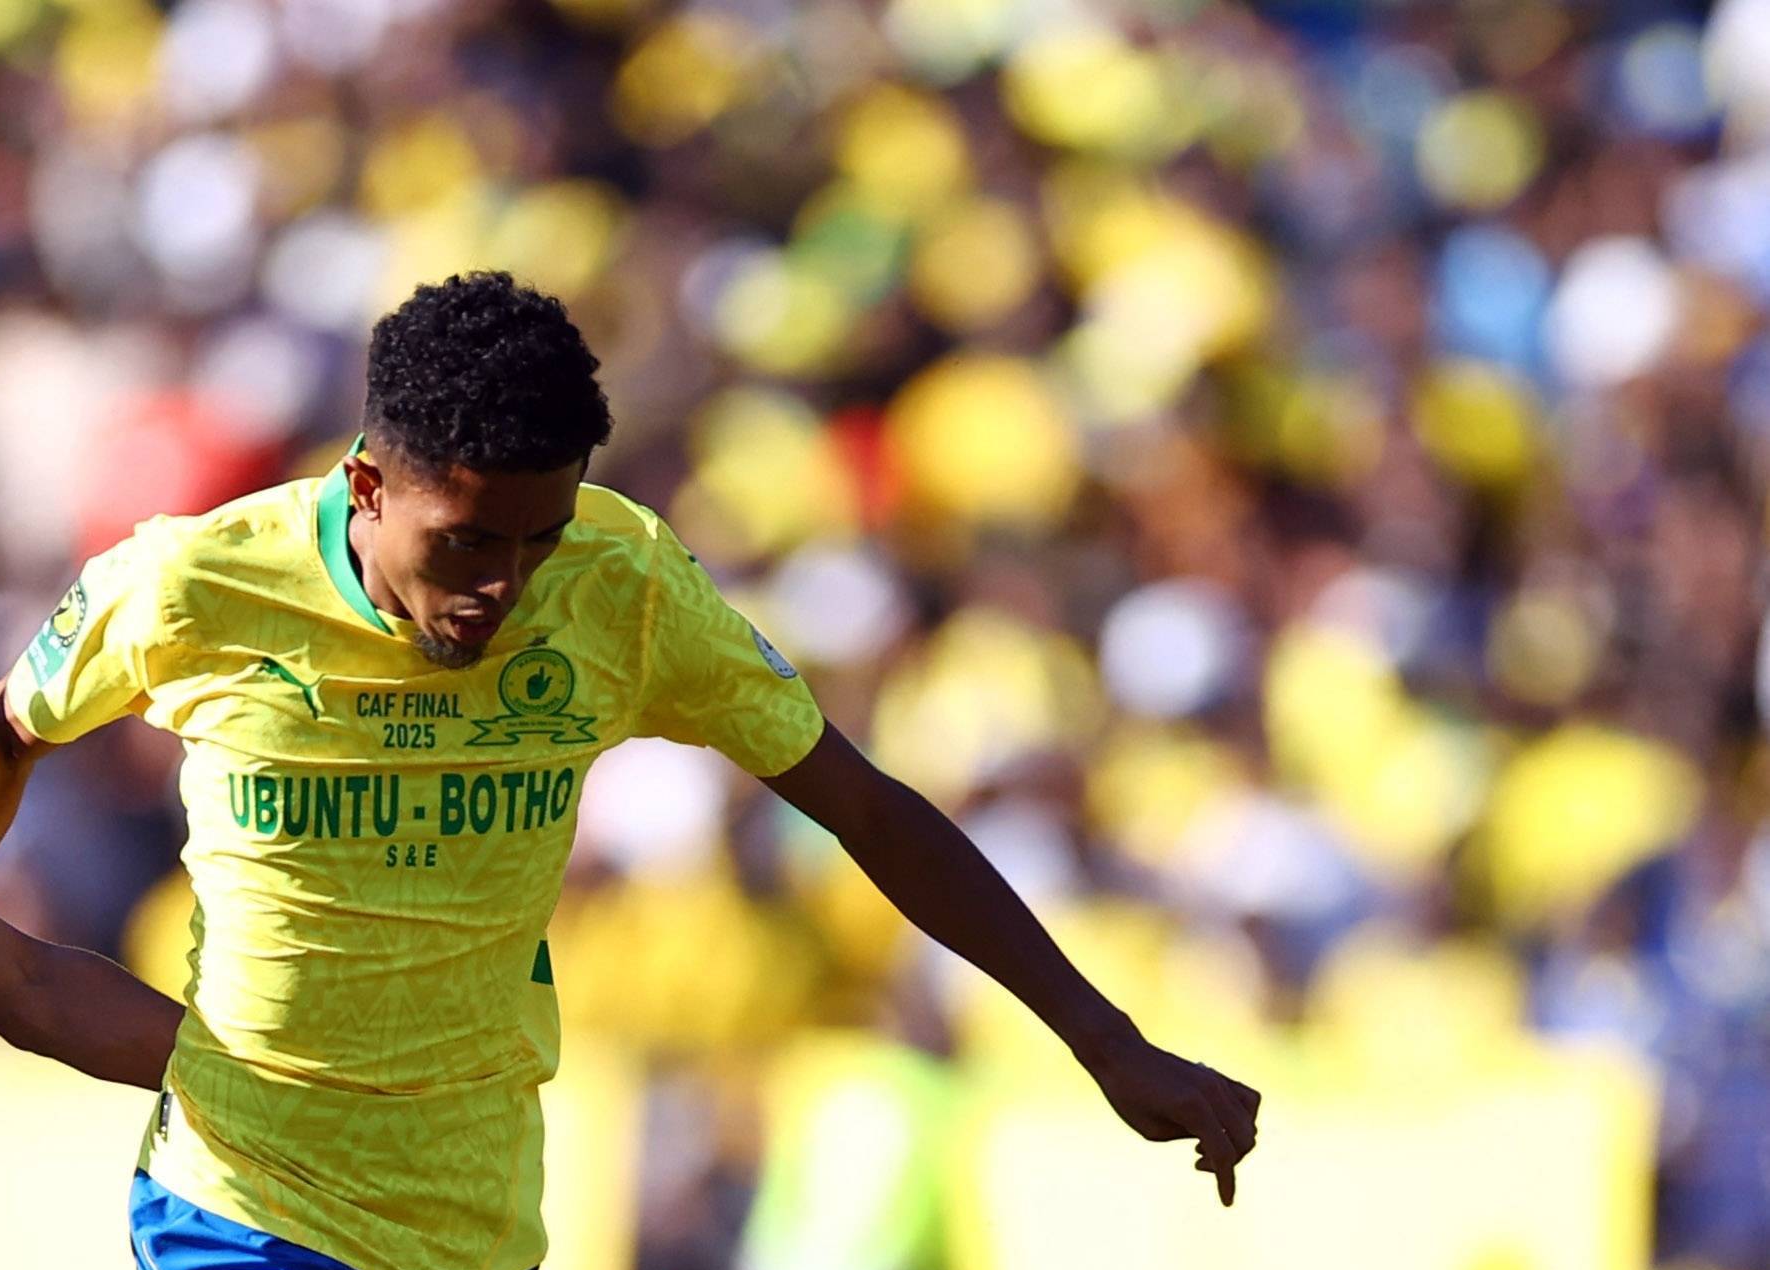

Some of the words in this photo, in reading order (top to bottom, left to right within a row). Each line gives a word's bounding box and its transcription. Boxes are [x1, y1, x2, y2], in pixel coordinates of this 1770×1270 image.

[356, 692, 397, 717] CAF
[403, 692, 464, 718] FINAL
[383, 722, 436, 749] 2025
[228, 773, 400, 838] UBUNTU
[440, 767, 574, 836] BOTHO
[386, 843, 398, 868] S
[405, 843, 417, 868] &
[424, 843, 438, 868] E
